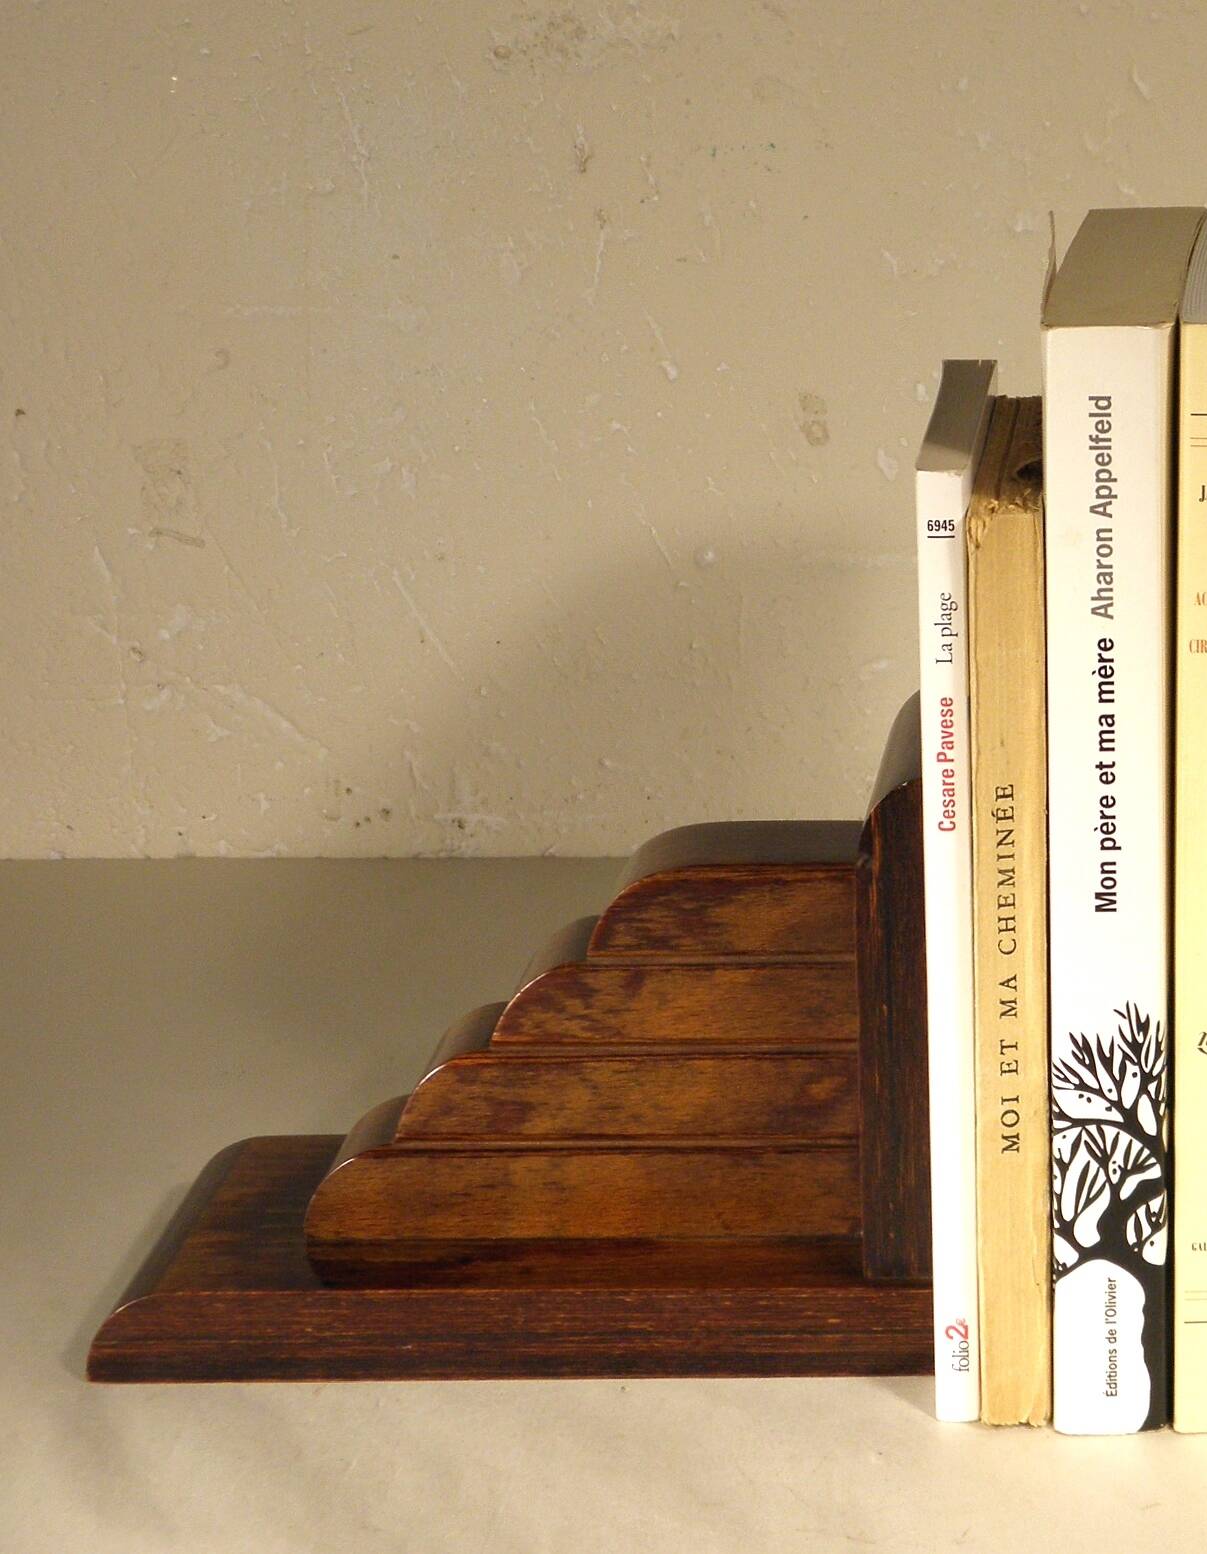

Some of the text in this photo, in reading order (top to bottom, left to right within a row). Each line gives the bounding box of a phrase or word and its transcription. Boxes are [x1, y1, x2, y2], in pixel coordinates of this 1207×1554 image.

[927, 519, 956, 532] 6945
[1088, 395, 1119, 621] Aharon Appelfeld
[936, 591, 959, 665] La plage
[936, 696, 957, 832] Cesare Pavese
[1091, 637, 1122, 913] Mon père et ma mère
[990, 783, 1021, 1155] MOI ET MA CHEMINÉE
[1102, 1277, 1118, 1398] Éditions de l'Olivier
